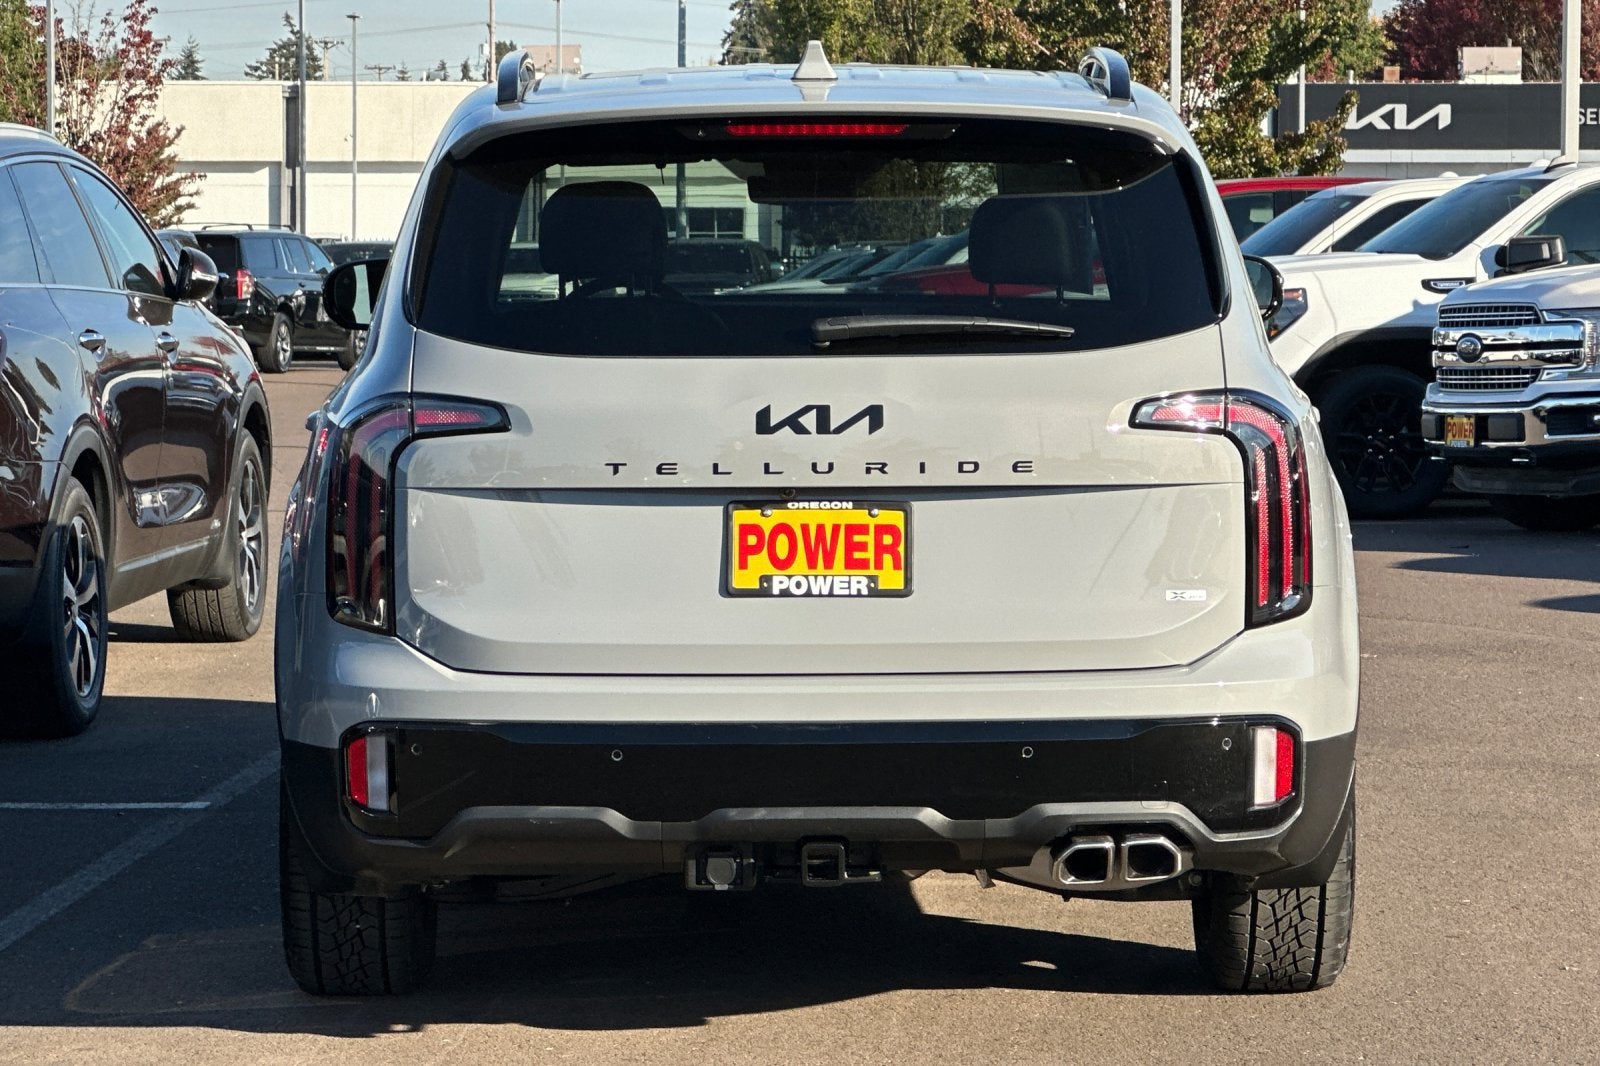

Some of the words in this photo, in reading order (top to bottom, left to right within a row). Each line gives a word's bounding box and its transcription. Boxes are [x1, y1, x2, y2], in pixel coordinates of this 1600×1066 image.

[1345, 103, 1451, 130] KIA
[1579, 107, 1600, 125] SE
[756, 404, 884, 435] KIA
[1447, 421, 1474, 438] POWER
[604, 461, 1035, 476] TELLURIDE
[787, 501, 853, 509] OREGON
[738, 522, 903, 571] POWER
[772, 575, 868, 595] POWER
